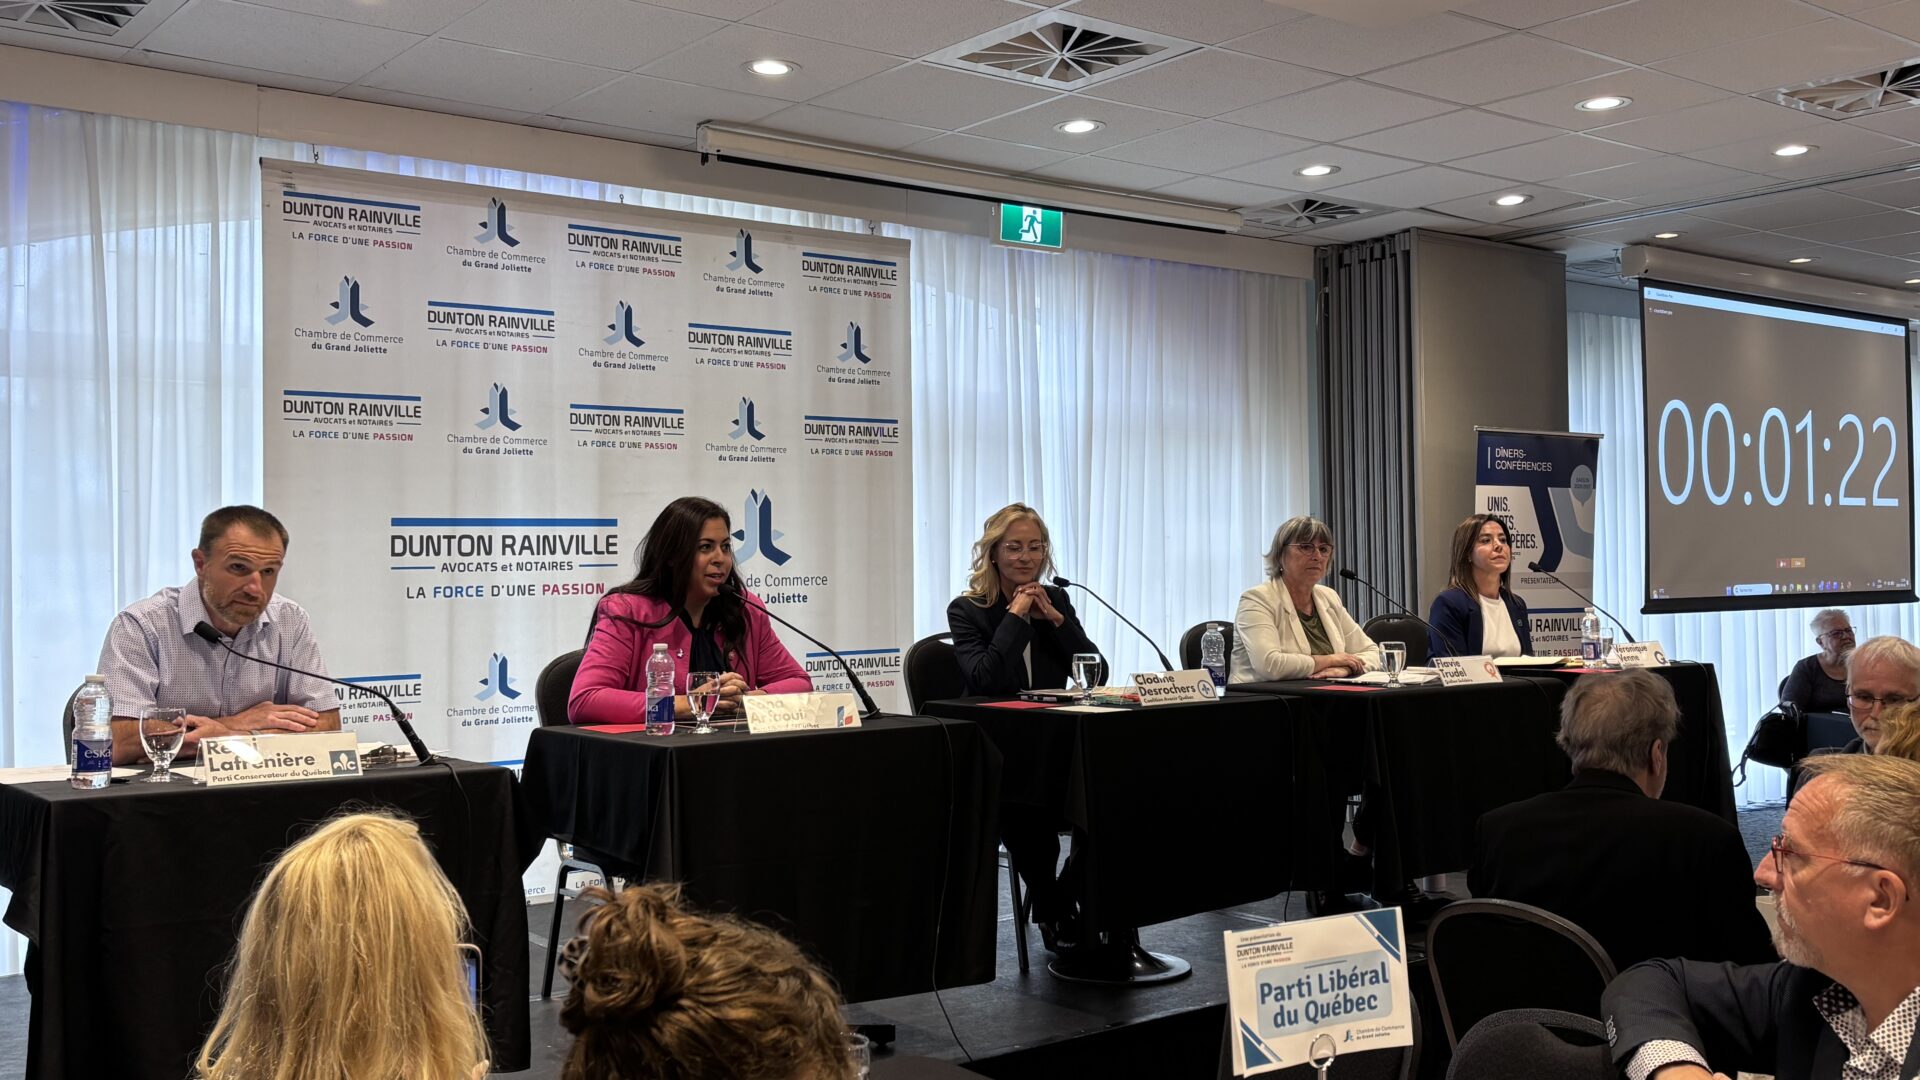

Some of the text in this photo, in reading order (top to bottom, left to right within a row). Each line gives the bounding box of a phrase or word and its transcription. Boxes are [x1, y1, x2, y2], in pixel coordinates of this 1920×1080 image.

[283, 201, 420, 228] DUNTON RAINVILLE
[308, 233, 338, 243] FORCE
[342, 237, 369, 246] D'UNE
[373, 240, 412, 250] PASSION
[568, 233, 682, 257] DUNTON RAINVILLE
[447, 246, 546, 264] Chambre de Commerce
[475, 261, 498, 269] Grand
[501, 264, 531, 272] Joliette
[589, 262, 614, 271] FORCE
[618, 265, 639, 274] D'UNE
[643, 268, 675, 277] PASSION
[802, 260, 896, 280] DUNTON RAINVILLE
[703, 273, 784, 288] Chambre de Commerce
[726, 286, 746, 294] Grand
[748, 289, 773, 297] Joliette
[820, 286, 840, 294] FORCE
[864, 291, 891, 299] PASSION
[428, 310, 554, 332] DUNTON RAINVILLE
[295, 328, 403, 344] Chambre de Commerce
[688, 332, 792, 350] DUNTON RAINVILLE
[325, 343, 350, 351] Grand
[354, 345, 387, 354] Joliette
[451, 340, 479, 348] FORCE
[483, 342, 508, 350] D'UNE
[512, 344, 547, 353] PASSION
[579, 348, 668, 362] Chambre de Commerce
[628, 363, 655, 371] Joliette
[708, 358, 730, 366] FORCE
[734, 360, 753, 368] D'UNE
[756, 362, 786, 370] PASSION
[817, 365, 846, 374] Chambre
[857, 368, 890, 377] Commerce
[284, 400, 421, 418] DUNTON RAINVILLE
[570, 413, 684, 429] DUNTON RAINVILLE
[343, 432, 369, 440] D'UNE
[373, 433, 413, 441] PASSION
[805, 424, 898, 438] DUNTON RAINVILLE
[447, 434, 547, 445] Chambre de Commerce
[591, 440, 616, 448] FORCE
[645, 442, 677, 450] PASSION
[706, 443, 787, 453] Chambre de Commerce
[1495, 446, 1527, 459] DÎNERS-
[1658, 399, 1899, 507] 00:01:22
[1495, 459, 1552, 472] CONFÉRENCES
[1487, 496, 1511, 512] UNIS.
[391, 534, 618, 557] DUNTON RAINVILLE
[441, 561, 574, 573] AVOCATS et NOTAIRES
[746, 574, 828, 587] de Commerce
[407, 583, 605, 598] LA FORCE D'UNE PASSION
[765, 592, 808, 604] Joliette
[1536, 619, 1582, 632] RAINVILL
[850, 656, 900, 669] RAINVILLE
[1435, 658, 1460, 668] Flavie
[1439, 667, 1467, 678] Trudel
[1135, 674, 1174, 685] Clodine
[349, 684, 421, 700] RAINVILLE
[1139, 684, 1196, 696] Desrochers
[357, 701, 390, 709] NOTAIRE
[447, 704, 537, 717] Chambre de Comme
[343, 715, 369, 724] D'UNE
[462, 716, 533, 727] du Grand Joliette
[84, 749, 111, 759] eska
[212, 774, 232, 783] Parti
[234, 771, 288, 781] Conservateur
[302, 768, 331, 777] Québec
[1236, 946, 1261, 958] DUNTON
[1262, 942, 1293, 953] RAINVILLE
[1259, 961, 1390, 1005] Parti Libéral
[1273, 993, 1378, 1028] du Québec
